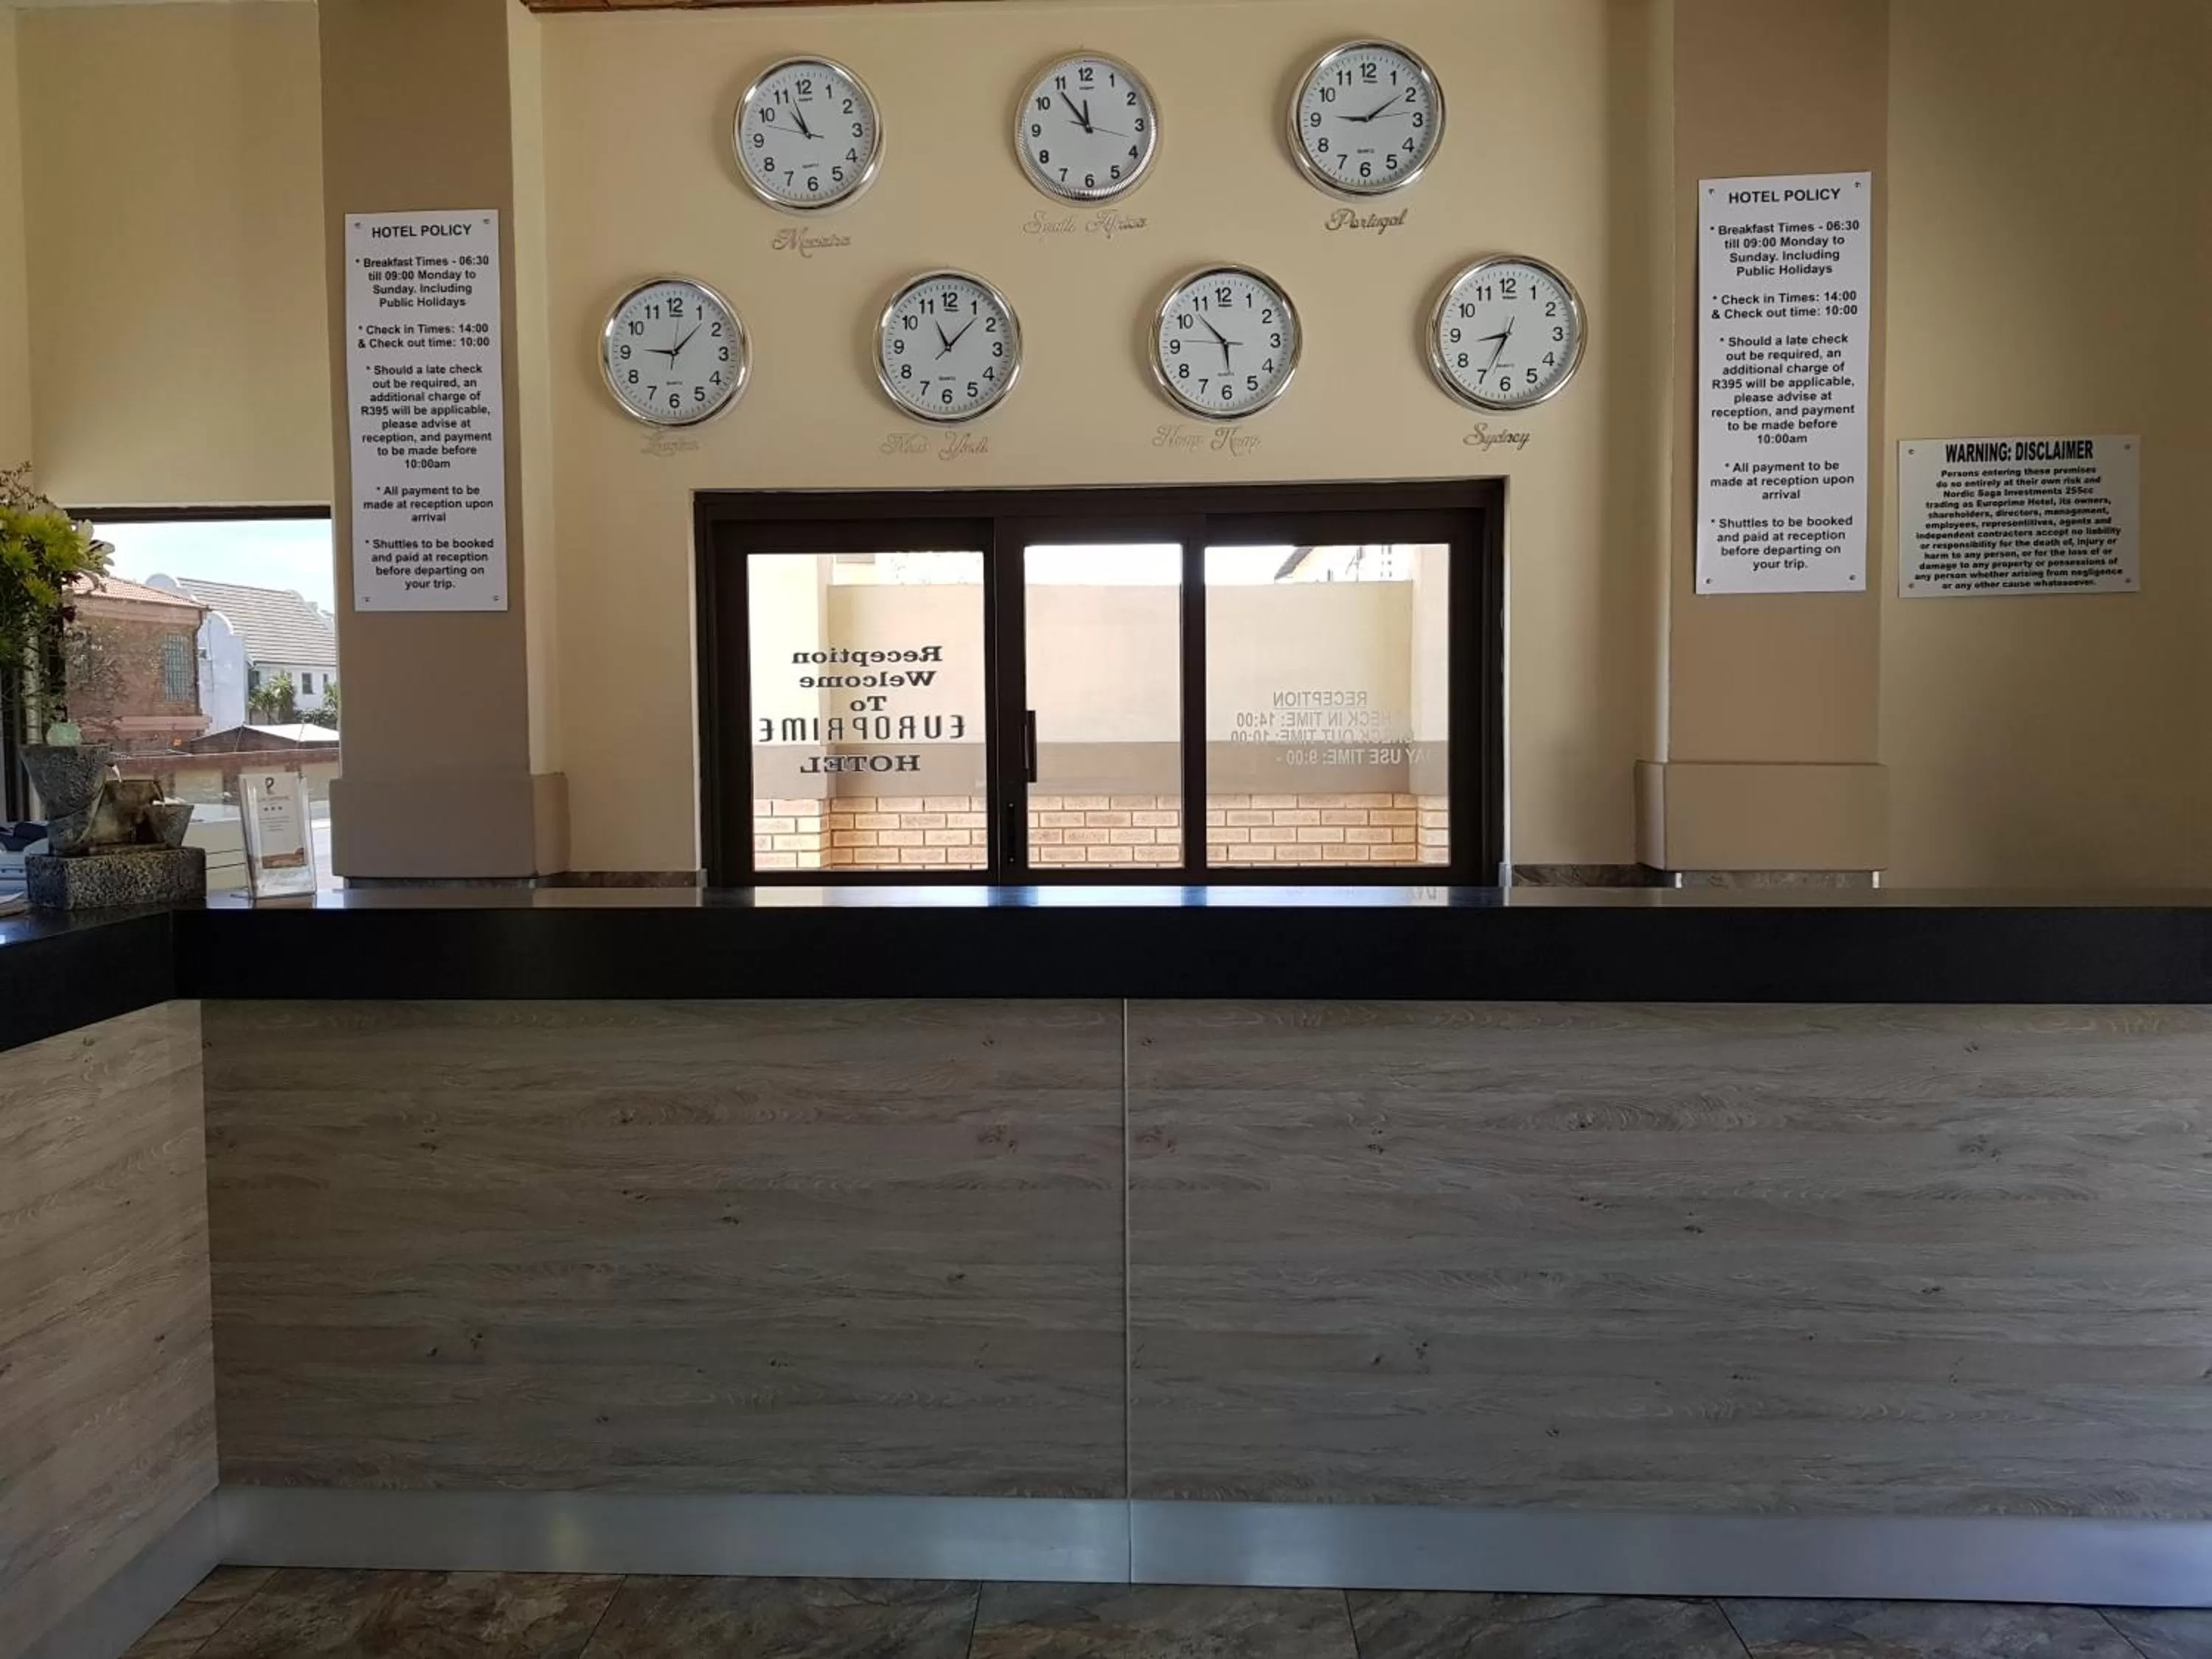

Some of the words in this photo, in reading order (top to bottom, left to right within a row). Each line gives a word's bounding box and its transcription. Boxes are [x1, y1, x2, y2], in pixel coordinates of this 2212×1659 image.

[1360, 63, 1377, 78] 12
[1338, 71, 1352, 86] 11
[1390, 71, 1397, 86] 1
[1320, 88, 1335, 102] 10
[1405, 87, 1416, 102] 2
[1310, 112, 1321, 127] 9
[1413, 112, 1423, 127] 3
[1318, 138, 1329, 153] 8
[1402, 137, 1415, 152] 4
[1336, 155, 1347, 170] 7
[1360, 162, 1371, 177] 6
[1386, 155, 1397, 170] 5
[1728, 190, 1780, 204] HOTEL
[1784, 188, 1840, 201] POLICY
[1325, 208, 1409, 234] Portugal
[1718, 223, 1774, 235] Breakfast
[1778, 222, 1815, 233] Times
[1826, 219, 1860, 231] 06:30
[372, 225, 417, 239] HOTEL
[420, 223, 471, 236] POLICY
[1724, 238, 1739, 249] till
[1743, 237, 1776, 248] 09:00
[1779, 235, 1829, 248] Monday
[1832, 235, 1845, 245] to
[363, 257, 413, 268] Breakfast
[415, 256, 448, 267] Times
[459, 254, 489, 265] 06:30
[1729, 251, 1778, 265] Sunday.
[1782, 248, 1840, 262] Including
[368, 271, 382, 281] till
[384, 270, 414, 280] 09:00
[417, 269, 462, 282] Monday
[465, 269, 476, 279] to
[1736, 265, 1775, 276] Public
[1778, 263, 1833, 276] Holidays
[420, 282, 472, 295] Including
[379, 297, 414, 307] Public
[417, 296, 466, 309] Holidays
[1721, 294, 1759, 305] Check
[1763, 293, 1774, 304] in
[1777, 292, 1820, 303] Times:
[1823, 290, 1857, 302] 14:00
[1711, 309, 1720, 319] &
[1724, 307, 1763, 319] Check
[1766, 307, 1787, 318] out
[1790, 306, 1820, 317] time:
[1825, 305, 1857, 316] 10:00
[366, 324, 401, 335] Check
[403, 324, 414, 334] in
[458, 323, 488, 334] 14:00
[358, 338, 366, 349] &
[368, 337, 404, 349] Check
[406, 338, 425, 347] out
[459, 336, 490, 347] 10:00
[1728, 335, 1771, 347] Should
[1775, 337, 1782, 346] a
[1786, 335, 1808, 345] late
[1812, 333, 1848, 344] check
[1726, 350, 1746, 361] out
[1749, 350, 1764, 361] be
[1767, 348, 1823, 362] required,
[1826, 349, 1841, 358] an
[1722, 363, 1783, 374] additional
[1786, 363, 1829, 375] charge
[1832, 361, 1845, 372] of
[1711, 378, 1742, 389] R395
[1745, 378, 1766, 389] will
[1770, 378, 1785, 388] be
[1788, 375, 1854, 389] applicable,
[1733, 392, 1773, 405] please
[1776, 390, 1818, 401] advise
[1820, 391, 1832, 400] at
[1711, 406, 1771, 419] reception,
[1775, 405, 1798, 416] and
[1801, 404, 1854, 417] payment
[1728, 421, 1739, 431] to
[1742, 420, 1758, 431] be
[1761, 419, 1795, 430] made
[1798, 418, 1837, 429] before
[1463, 422, 1531, 451] Sydney
[1757, 433, 1807, 444] 10:00am
[1946, 442, 2011, 463] WARNING:
[2015, 439, 2093, 461] DISCLAIMER
[1732, 462, 1748, 473] All
[1752, 461, 1805, 474] payment
[1808, 461, 1820, 471] to
[1823, 460, 1839, 470] be
[1710, 476, 1742, 487] made
[1746, 476, 1758, 486] at
[1761, 474, 1818, 488] reception
[1822, 476, 1854, 487] upon
[1761, 489, 1801, 500] arrival
[1719, 518, 1769, 531] Shuttles
[1772, 518, 1784, 527] to
[1787, 516, 1803, 527] be
[1806, 515, 1852, 526] booked
[1717, 532, 1739, 542] and
[1742, 531, 1769, 544] paid
[1772, 532, 1784, 541] at
[1787, 529, 1845, 543] reception
[1721, 546, 1760, 556] before
[1763, 543, 1821, 557] departing
[1825, 545, 1840, 554] on
[1753, 560, 1781, 571] your
[1784, 558, 1808, 571] trip.
